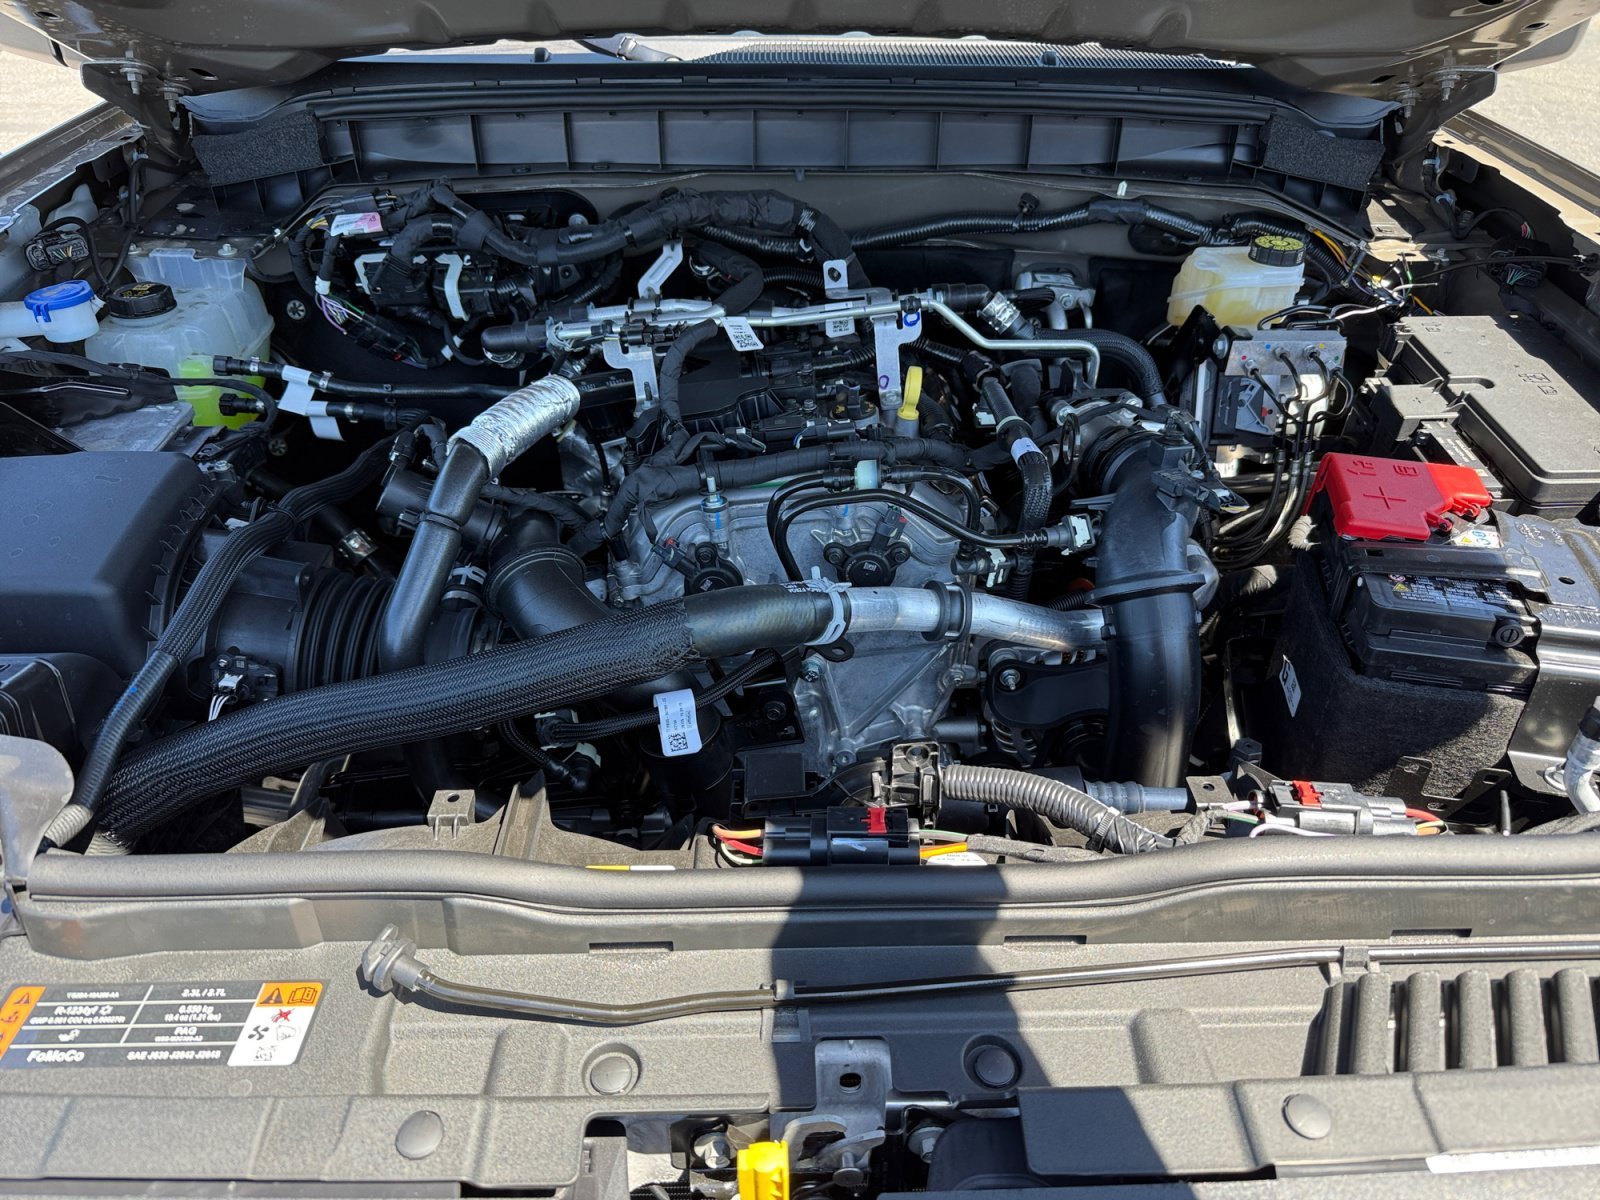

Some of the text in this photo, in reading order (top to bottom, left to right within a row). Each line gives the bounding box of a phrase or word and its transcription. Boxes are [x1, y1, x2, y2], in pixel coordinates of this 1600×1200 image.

[181, 988, 201, 997] 2.3L
[207, 988, 226, 997] 2.7L
[26, 1049, 85, 1062] FoMoCo
